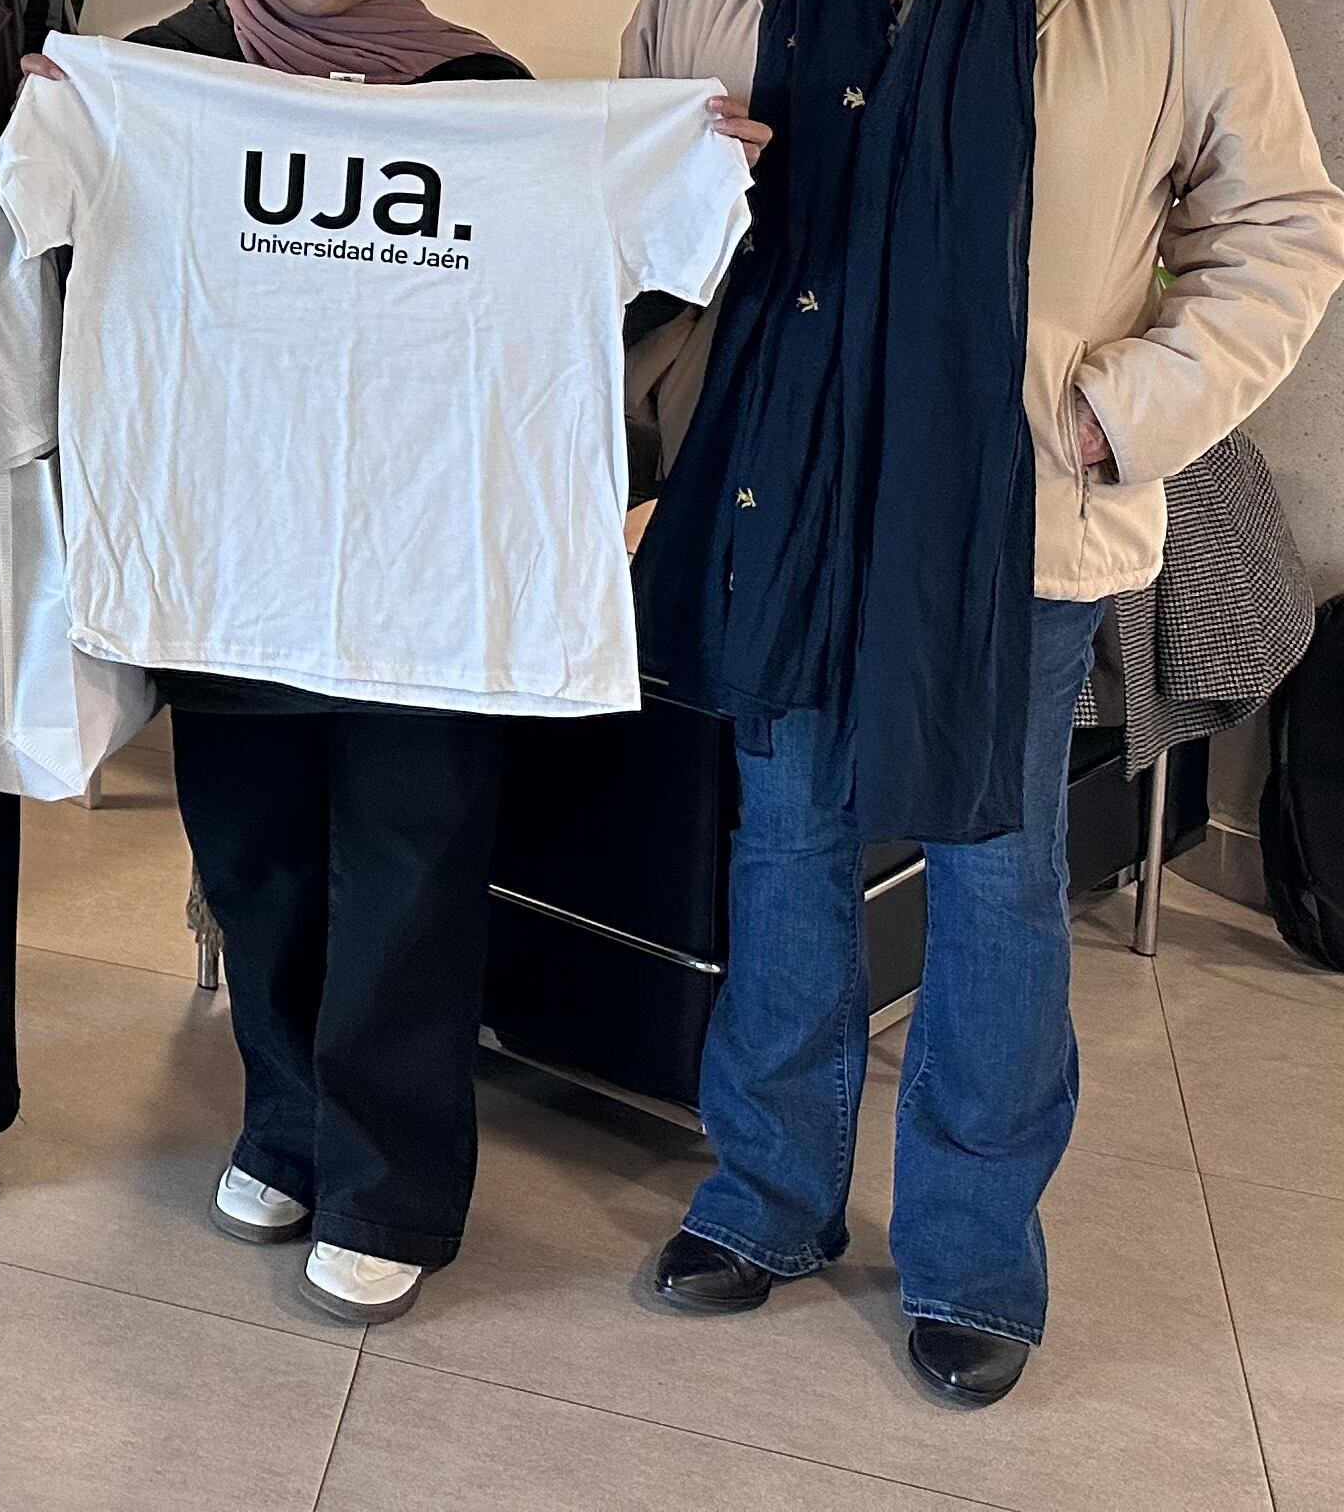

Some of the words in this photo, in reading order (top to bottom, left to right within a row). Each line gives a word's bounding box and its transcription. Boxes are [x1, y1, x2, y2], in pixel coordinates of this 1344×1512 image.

[240, 231, 375, 262] Universidad
[380, 243, 408, 265] de
[413, 246, 470, 270] Jaén
